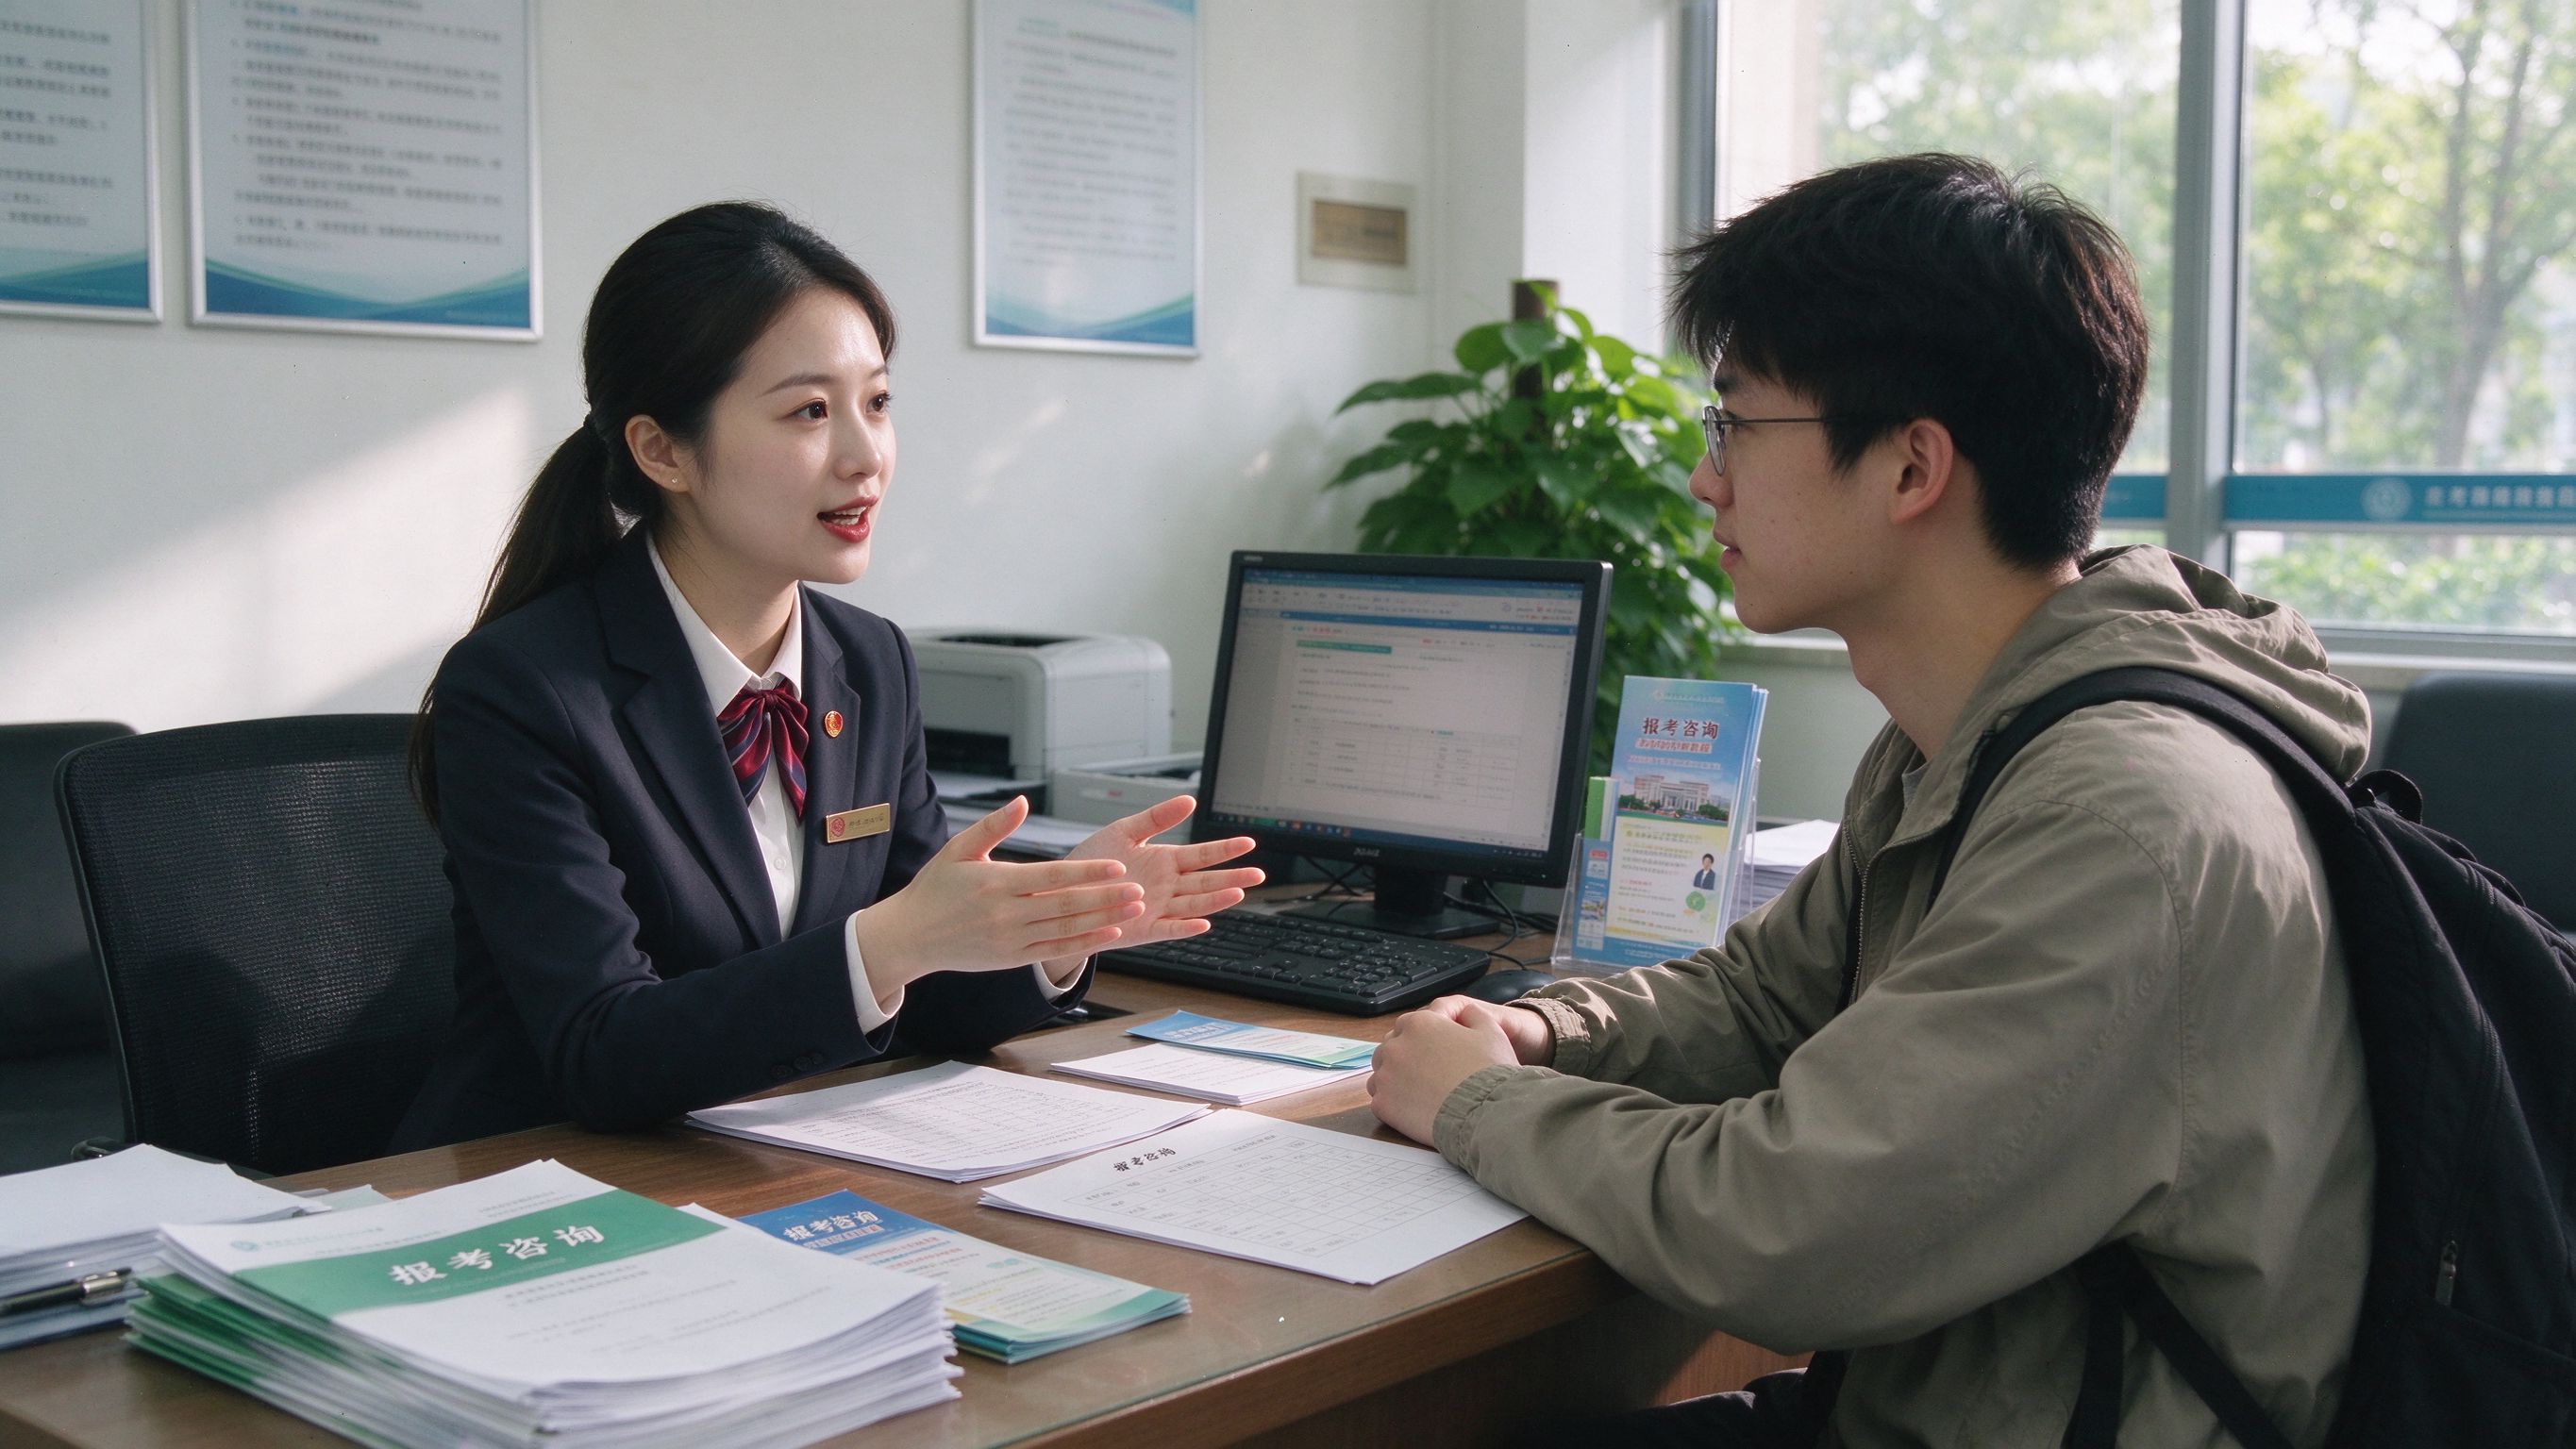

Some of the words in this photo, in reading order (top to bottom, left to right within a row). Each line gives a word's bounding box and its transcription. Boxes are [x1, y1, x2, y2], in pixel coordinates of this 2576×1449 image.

[1642, 717, 1719, 740] 报考咨询
[783, 1210, 878, 1241] 报考咨询
[389, 1225, 605, 1286] 报考咨询
